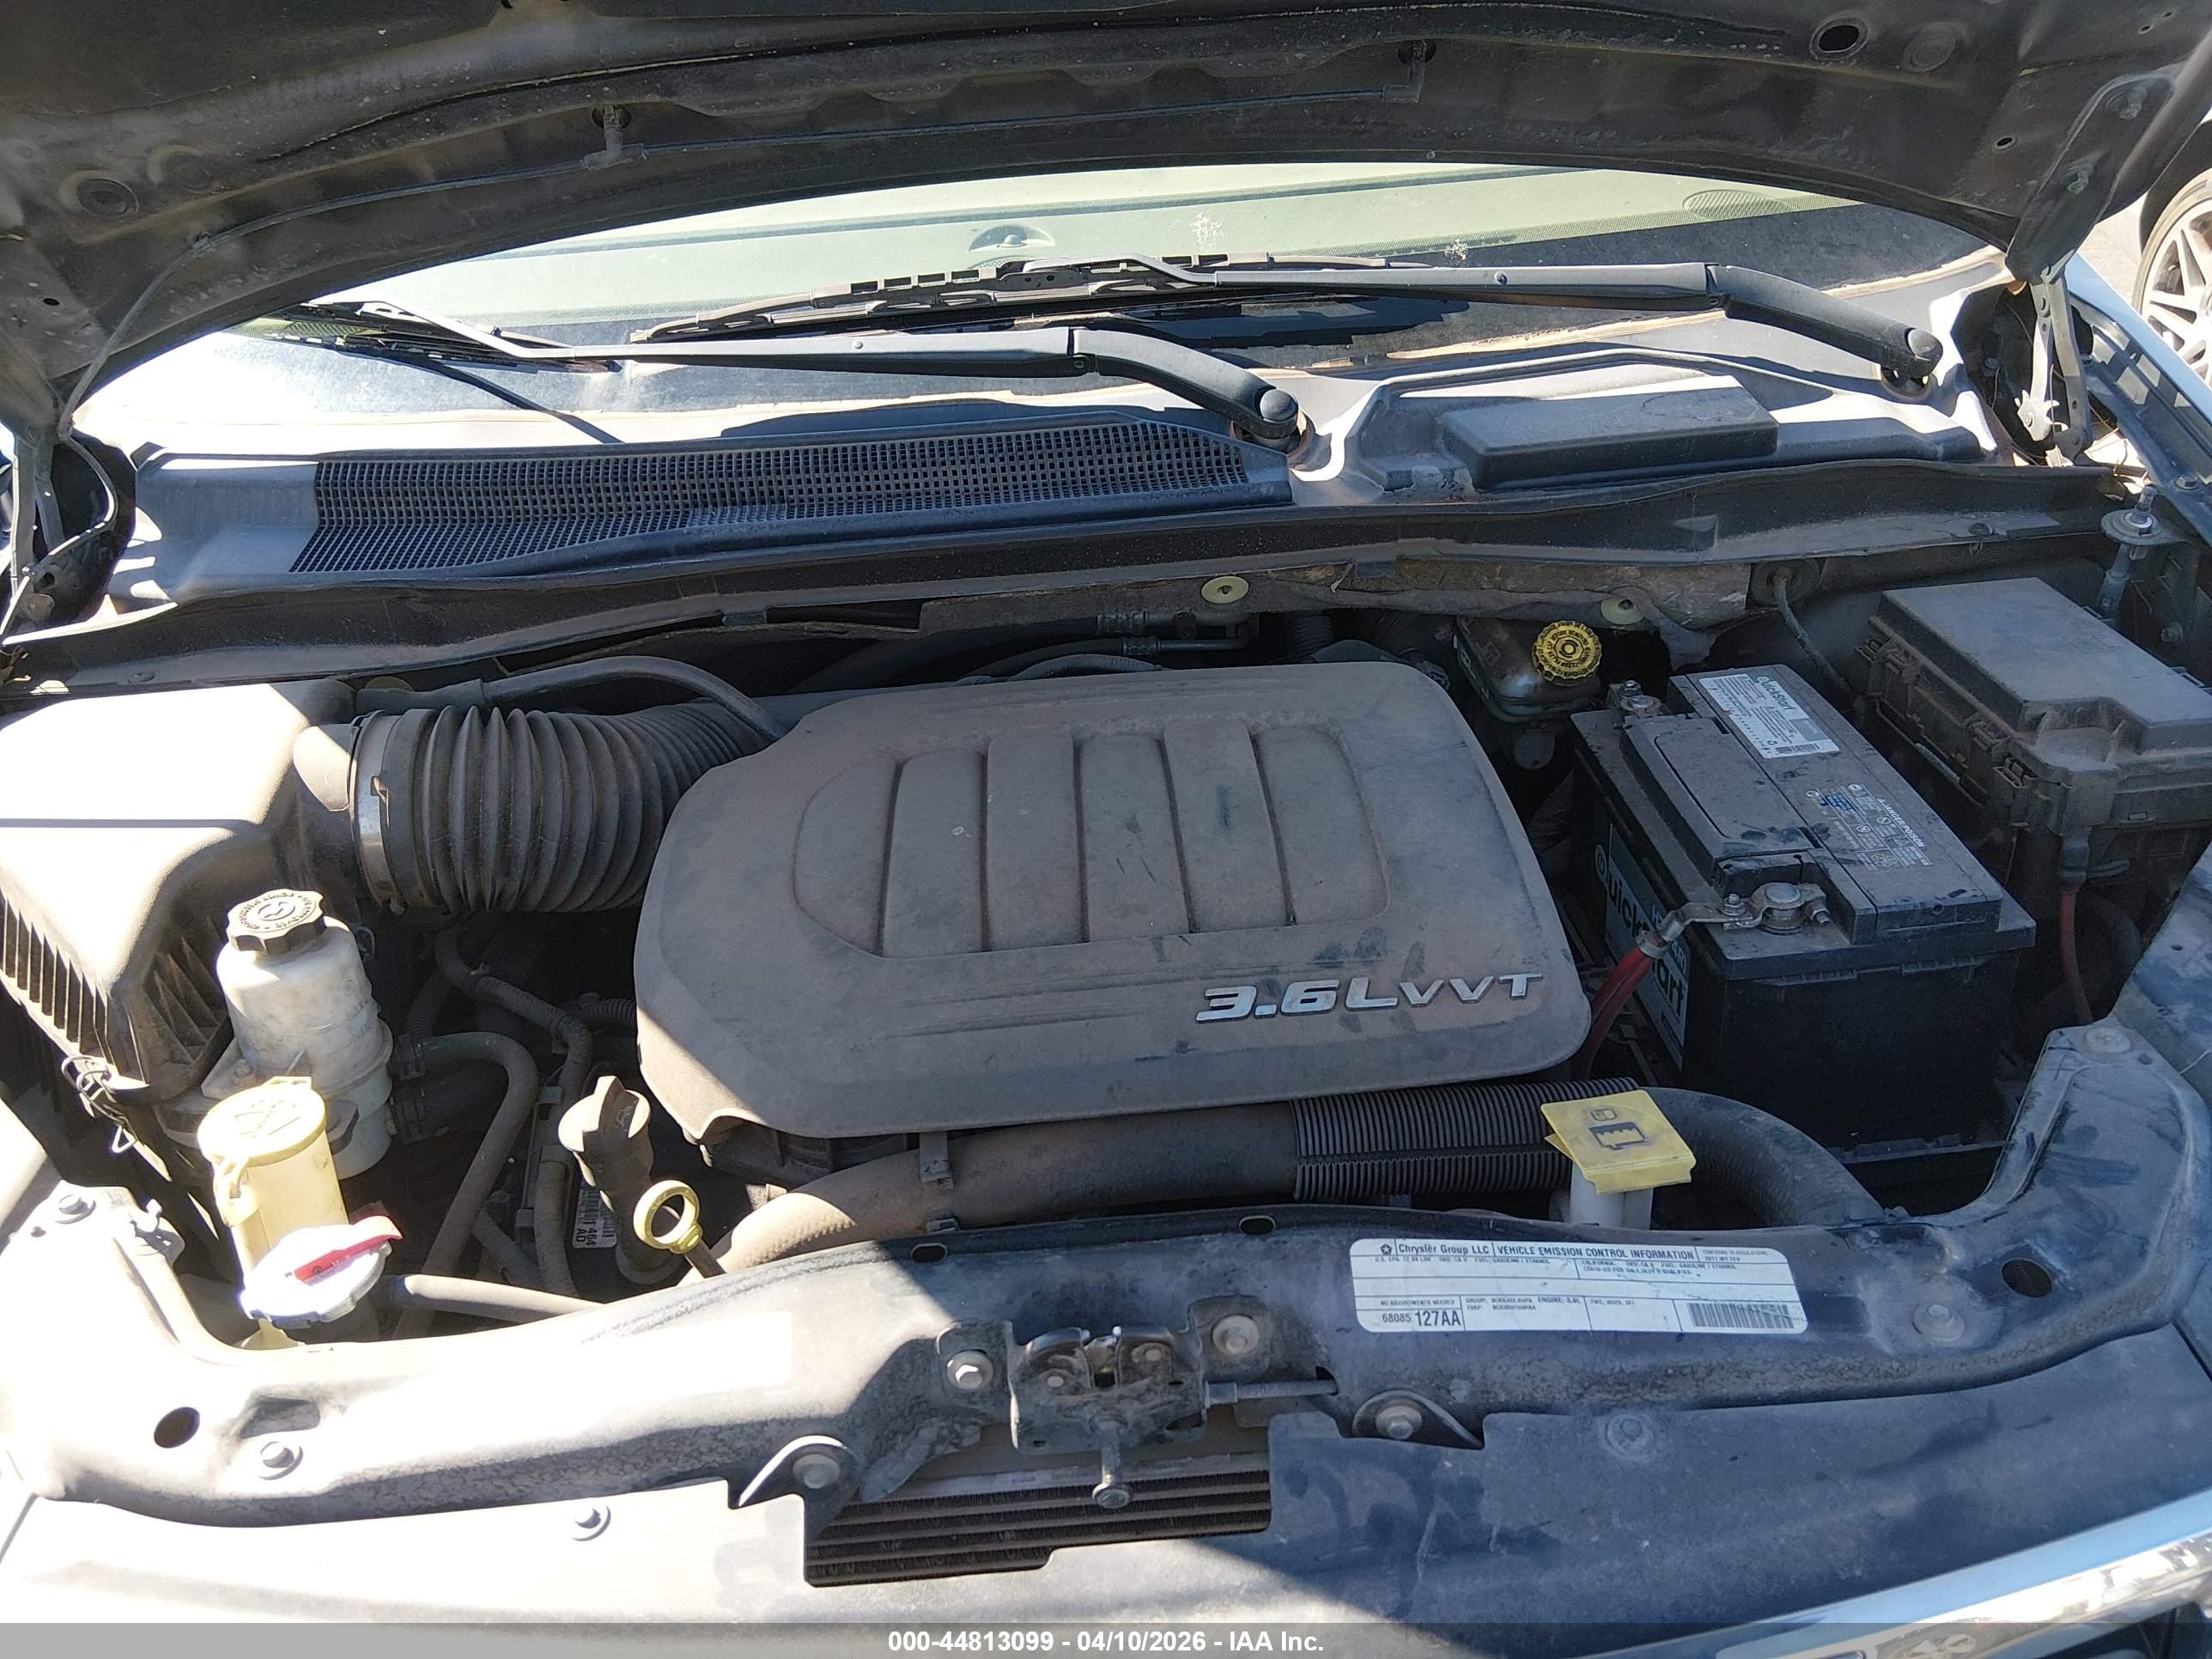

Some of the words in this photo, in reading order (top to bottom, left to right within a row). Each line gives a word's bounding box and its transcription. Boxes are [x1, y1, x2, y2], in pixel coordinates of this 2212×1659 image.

[1757, 676, 1796, 710] QuickStart
[1195, 977, 1398, 1024] 3.6L
[1399, 972, 1542, 1008] VVT
[1398, 1243, 1437, 1255] Chrysler
[1440, 1244, 1468, 1255] Group
[1472, 1245, 1489, 1255] LLC
[1498, 1245, 1535, 1255] VEHICLE
[1538, 1247, 1583, 1257] EMISSION
[1585, 1247, 1628, 1258] CONTROL
[1632, 1249, 1694, 1260] INFORMATION
[1382, 1312, 1412, 1323] 68085
[1415, 1310, 1462, 1328] 127AA
